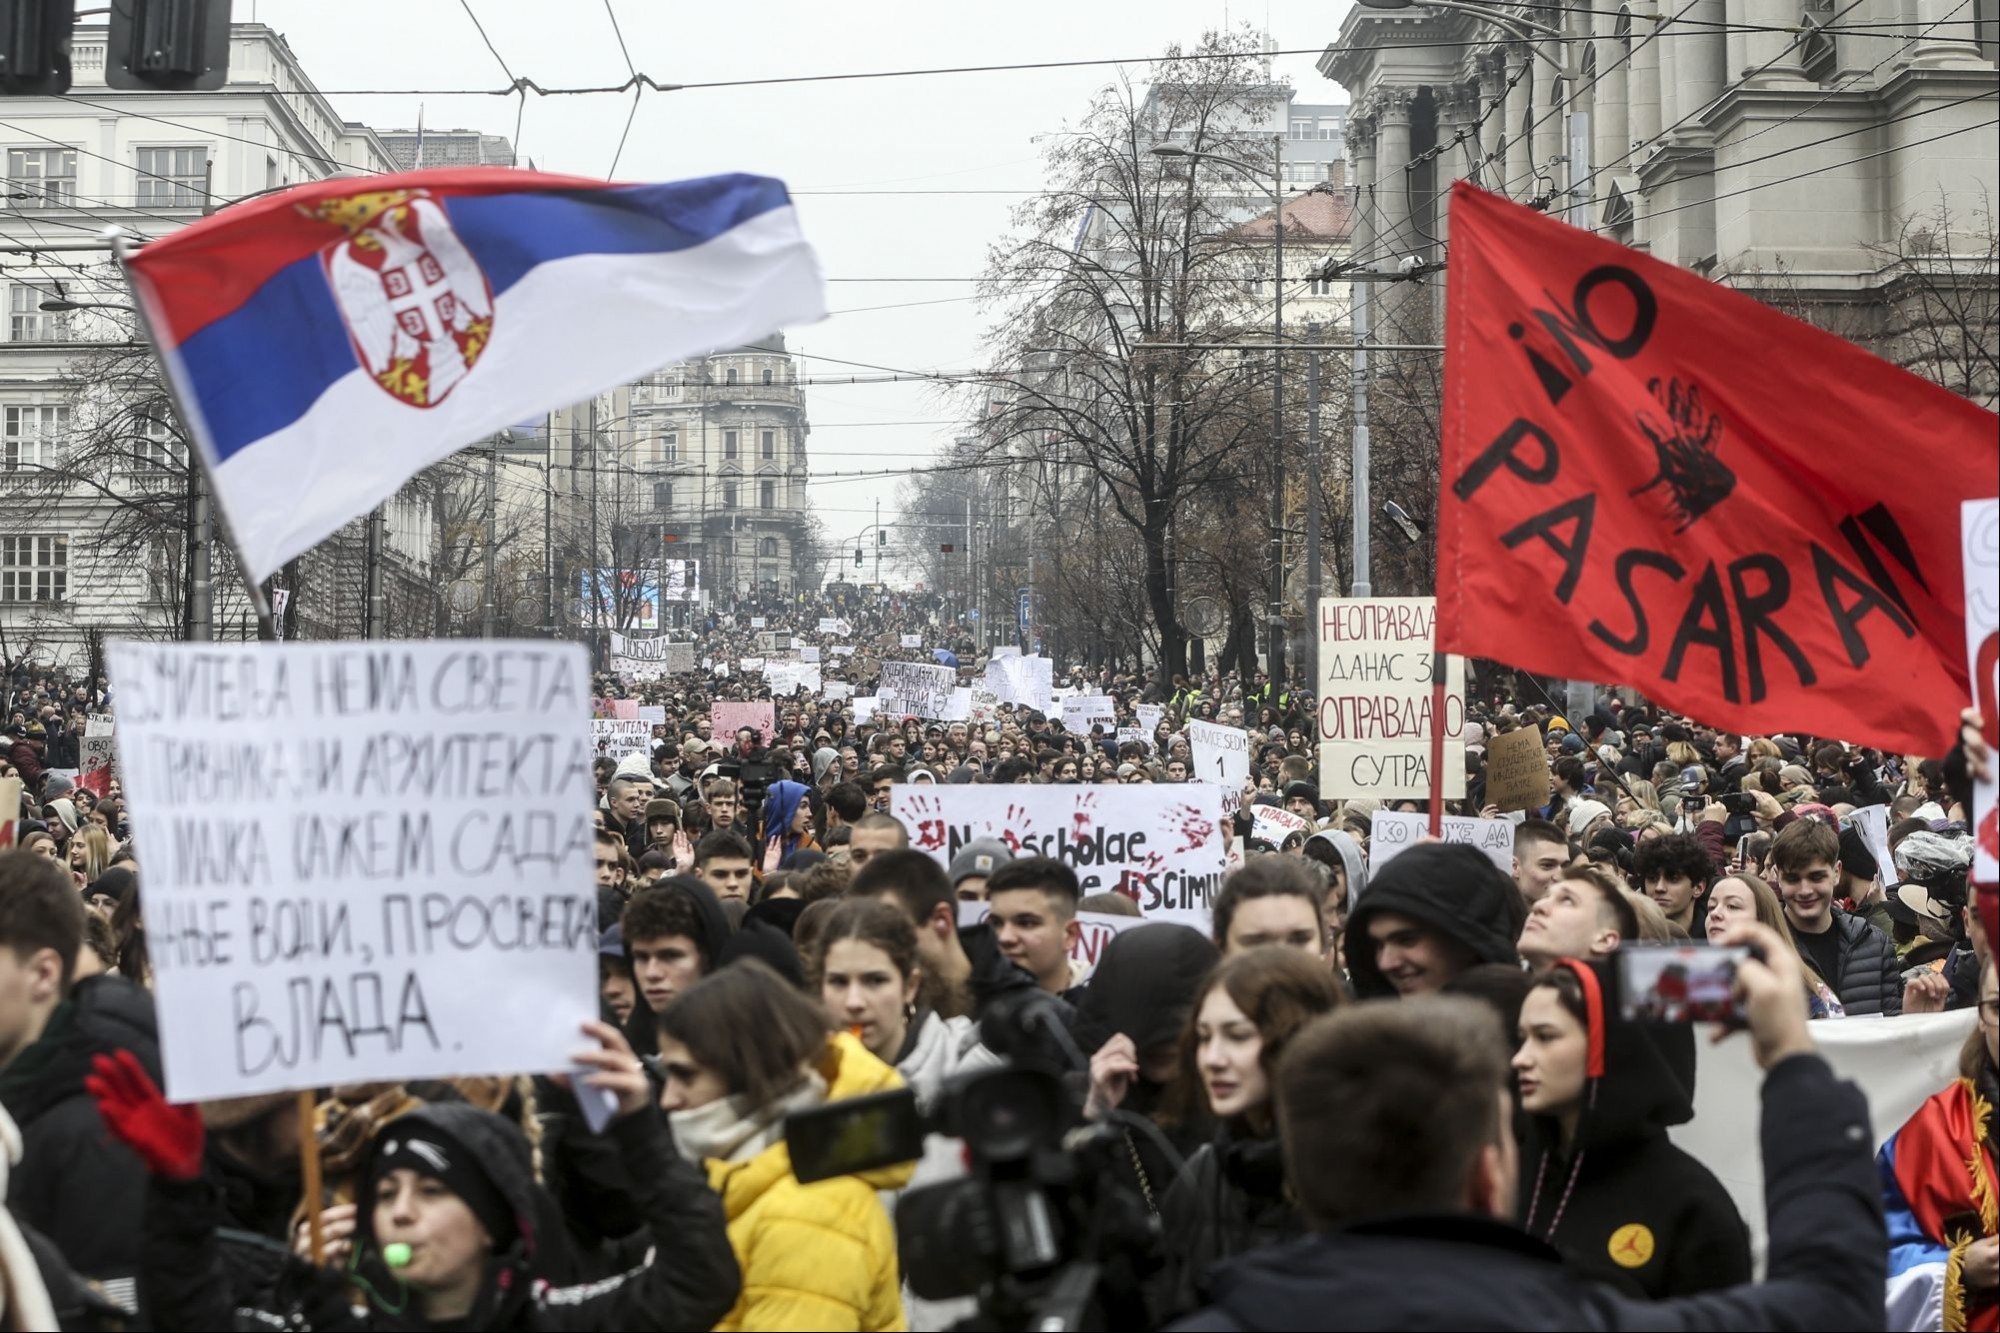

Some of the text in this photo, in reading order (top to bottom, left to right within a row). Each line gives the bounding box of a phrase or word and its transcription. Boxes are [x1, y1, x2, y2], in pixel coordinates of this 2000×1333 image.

[1322, 604, 1437, 642] НЕОПРАВДА
[429, 650, 579, 716] СВЕТА
[1328, 653, 1433, 682] ДАНАС З
[1320, 694, 1464, 739] ОПРАВДАО
[352, 730, 591, 800] АРХИТЕКТА
[1350, 754, 1431, 787] СУТРА
[1259, 806, 1303, 828] ПРАВДА
[1377, 820, 1408, 843] КО
[1481, 823, 1510, 848] ДА
[449, 808, 592, 882] САДА
[380, 891, 600, 959] ПРОСВЕТА
[232, 970, 463, 1078] ВЛАДА.
